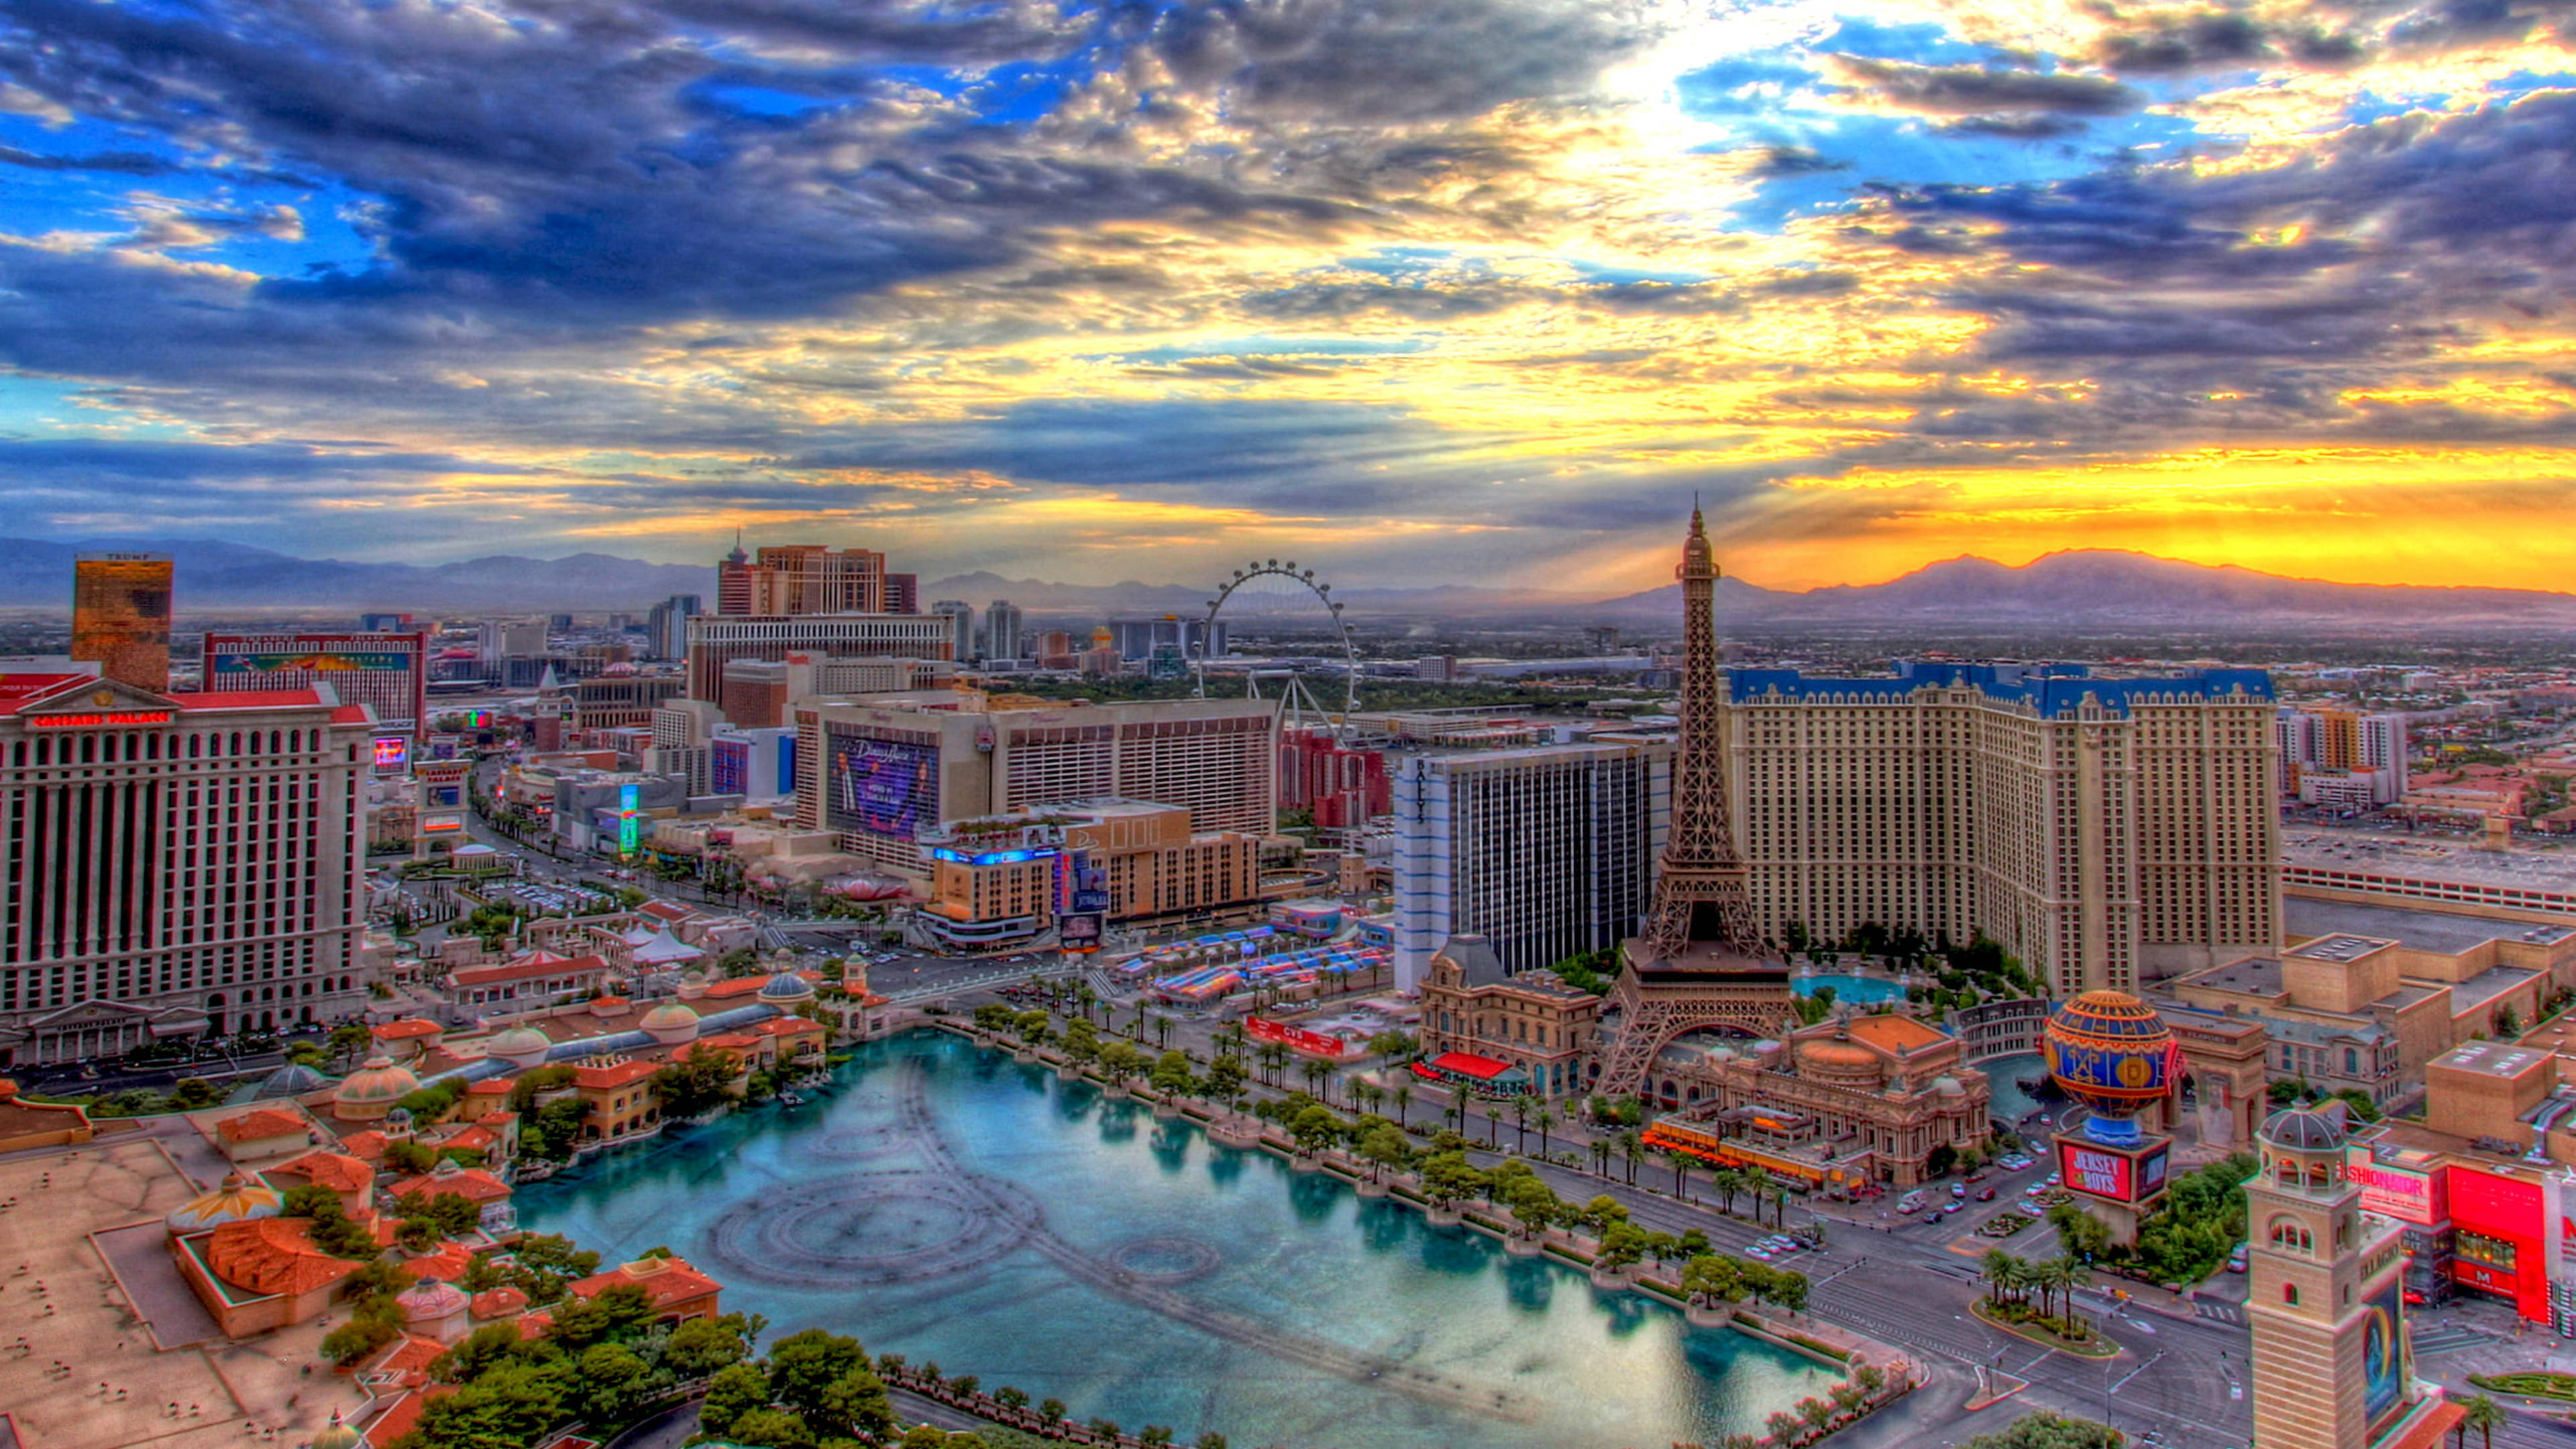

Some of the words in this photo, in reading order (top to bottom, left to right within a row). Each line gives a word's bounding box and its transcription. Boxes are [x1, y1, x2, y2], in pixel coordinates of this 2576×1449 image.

[34, 714, 103, 727] CAESARS
[108, 712, 169, 724] PALACE
[1283, 1026, 1303, 1040] CVS
[2074, 1150, 2118, 1175] JERSEY
[2083, 1171, 2116, 1193] BOYS
